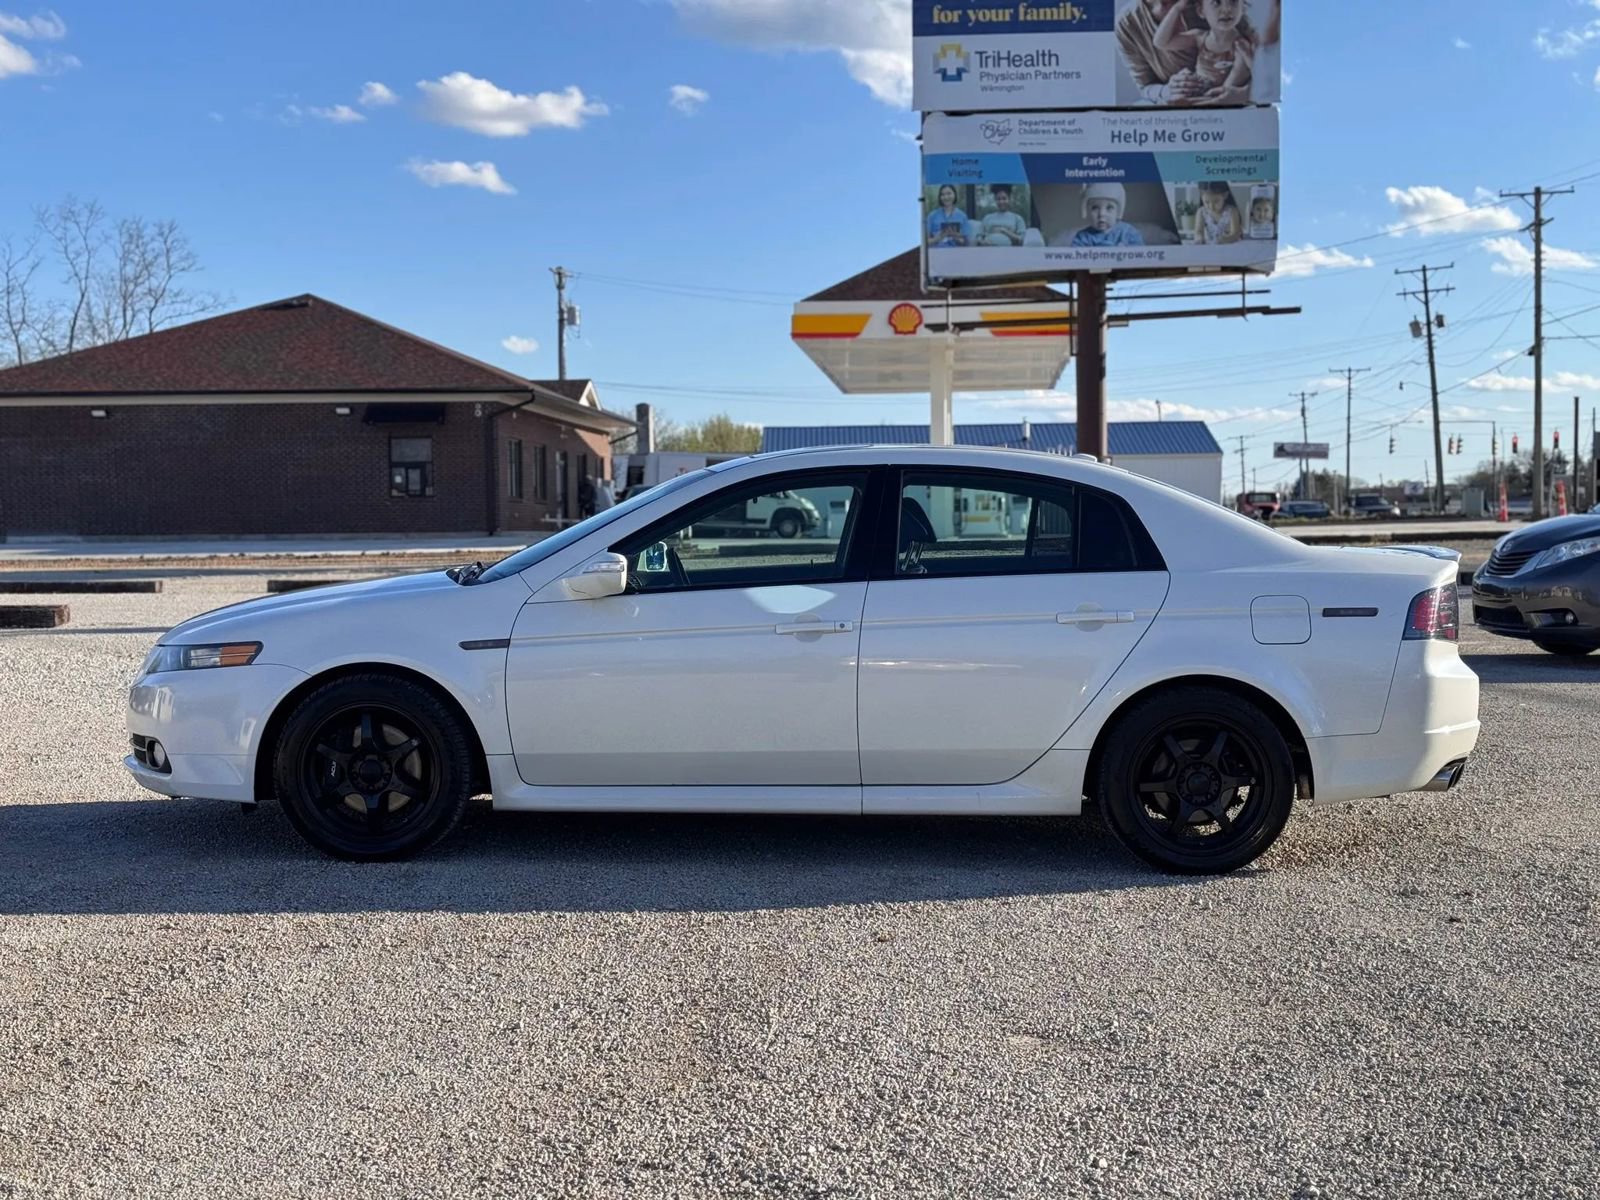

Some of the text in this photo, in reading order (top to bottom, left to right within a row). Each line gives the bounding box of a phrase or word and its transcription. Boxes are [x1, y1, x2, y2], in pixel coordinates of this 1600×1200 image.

[933, 2, 1087, 26] for your family.
[975, 49, 1060, 68] TriHealth
[980, 69, 1081, 83] Physician Partners
[1018, 118, 1076, 127] Department of
[1061, 127, 1083, 135] Youth
[1110, 128, 1225, 146] Help Me Grow
[951, 157, 979, 166] Home
[1082, 156, 1108, 168] Early
[1195, 154, 1267, 164] Developmental
[1065, 168, 1125, 178] Intervention
[1205, 165, 1257, 176] Screenings
[1044, 250, 1165, 261] www.helpmegrow.org
